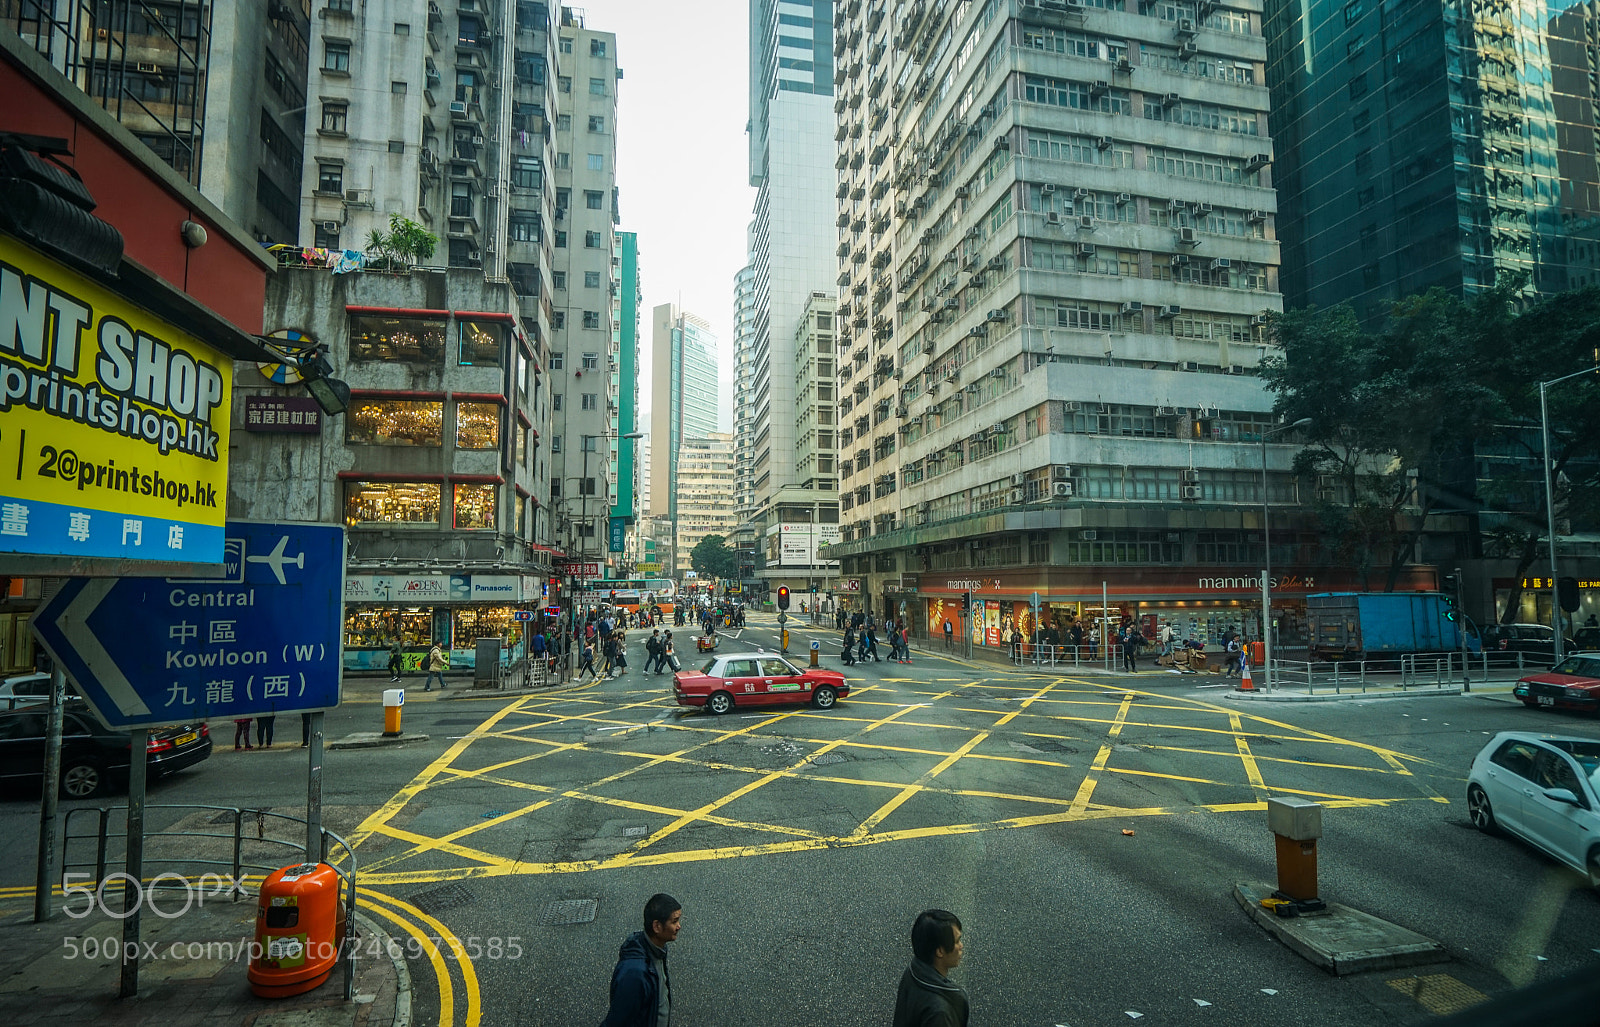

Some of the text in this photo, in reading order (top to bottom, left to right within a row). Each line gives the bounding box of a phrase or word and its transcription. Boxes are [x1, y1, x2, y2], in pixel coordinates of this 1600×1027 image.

[98, 319, 222, 423] SHOP
[248, 410, 317, 425] 家居建材城
[37, 444, 218, 508] 2@printshop.hk
[169, 588, 255, 607] Central
[475, 584, 513, 592] Panasonic
[169, 619, 237, 645] 中區
[165, 648, 268, 669] Kowloon
